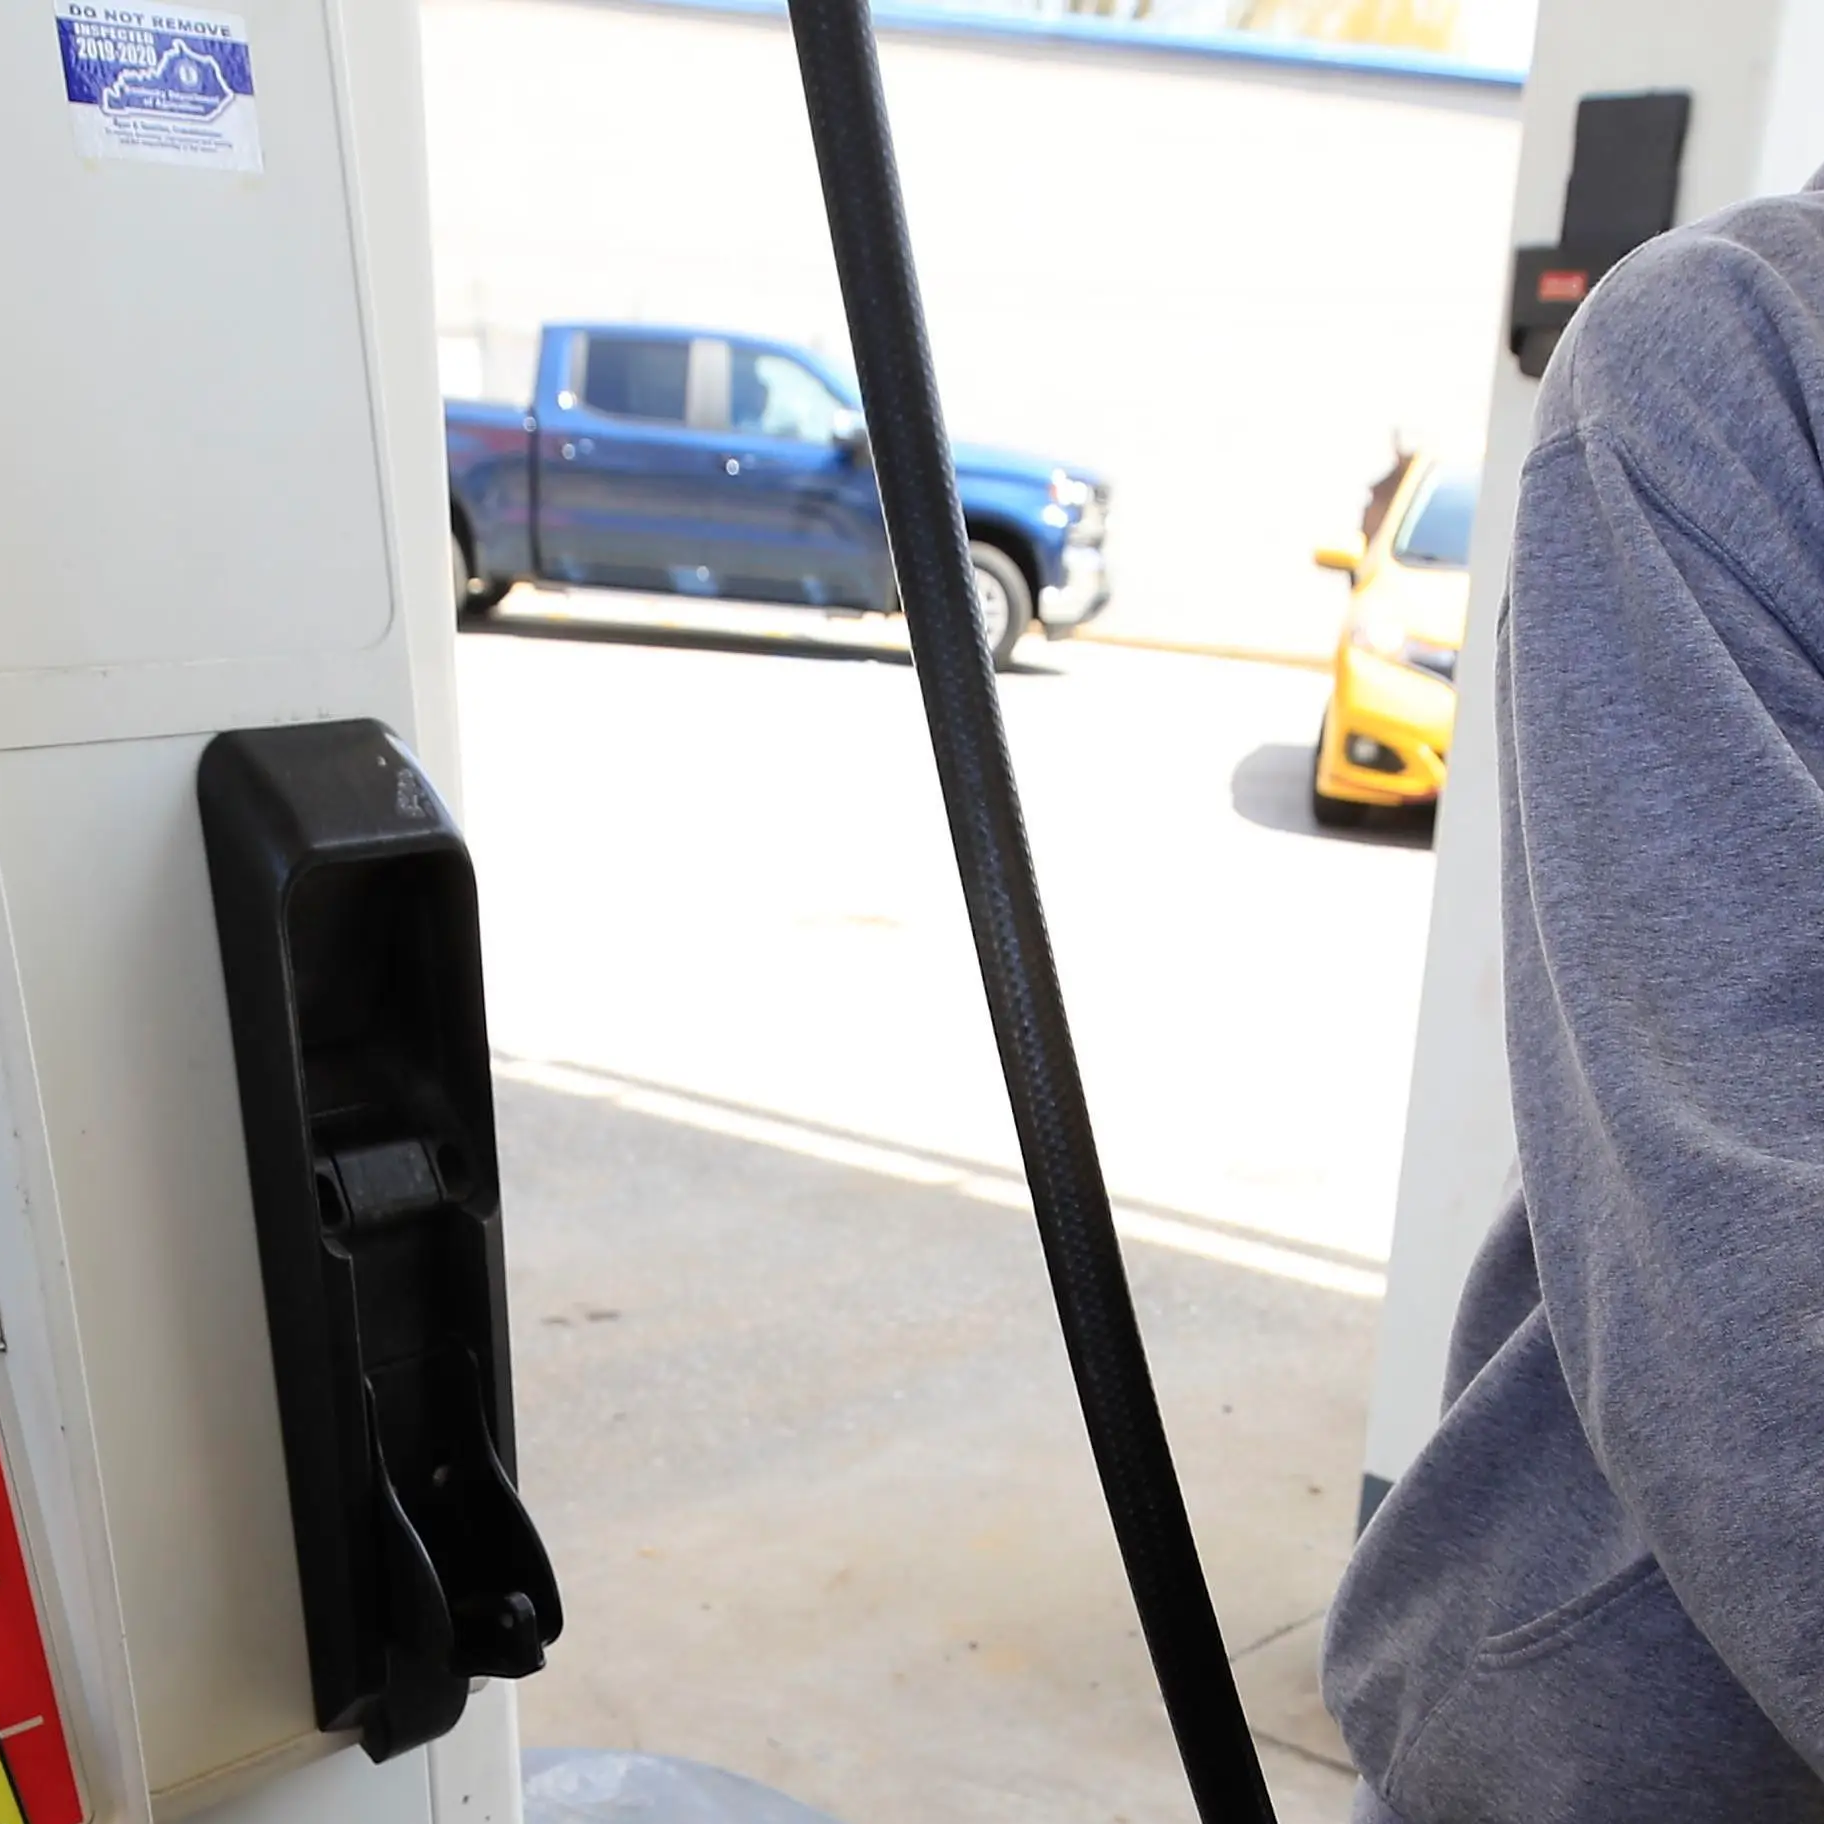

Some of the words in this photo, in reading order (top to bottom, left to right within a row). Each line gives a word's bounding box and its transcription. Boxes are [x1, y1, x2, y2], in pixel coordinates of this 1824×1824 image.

[69, 4, 97, 18] DO
[105, 10, 144, 26] NOT
[152, 16, 231, 37] REMOVE
[74, 22, 155, 45] INSPECTED
[77, 37, 157, 66] 2019-2020
